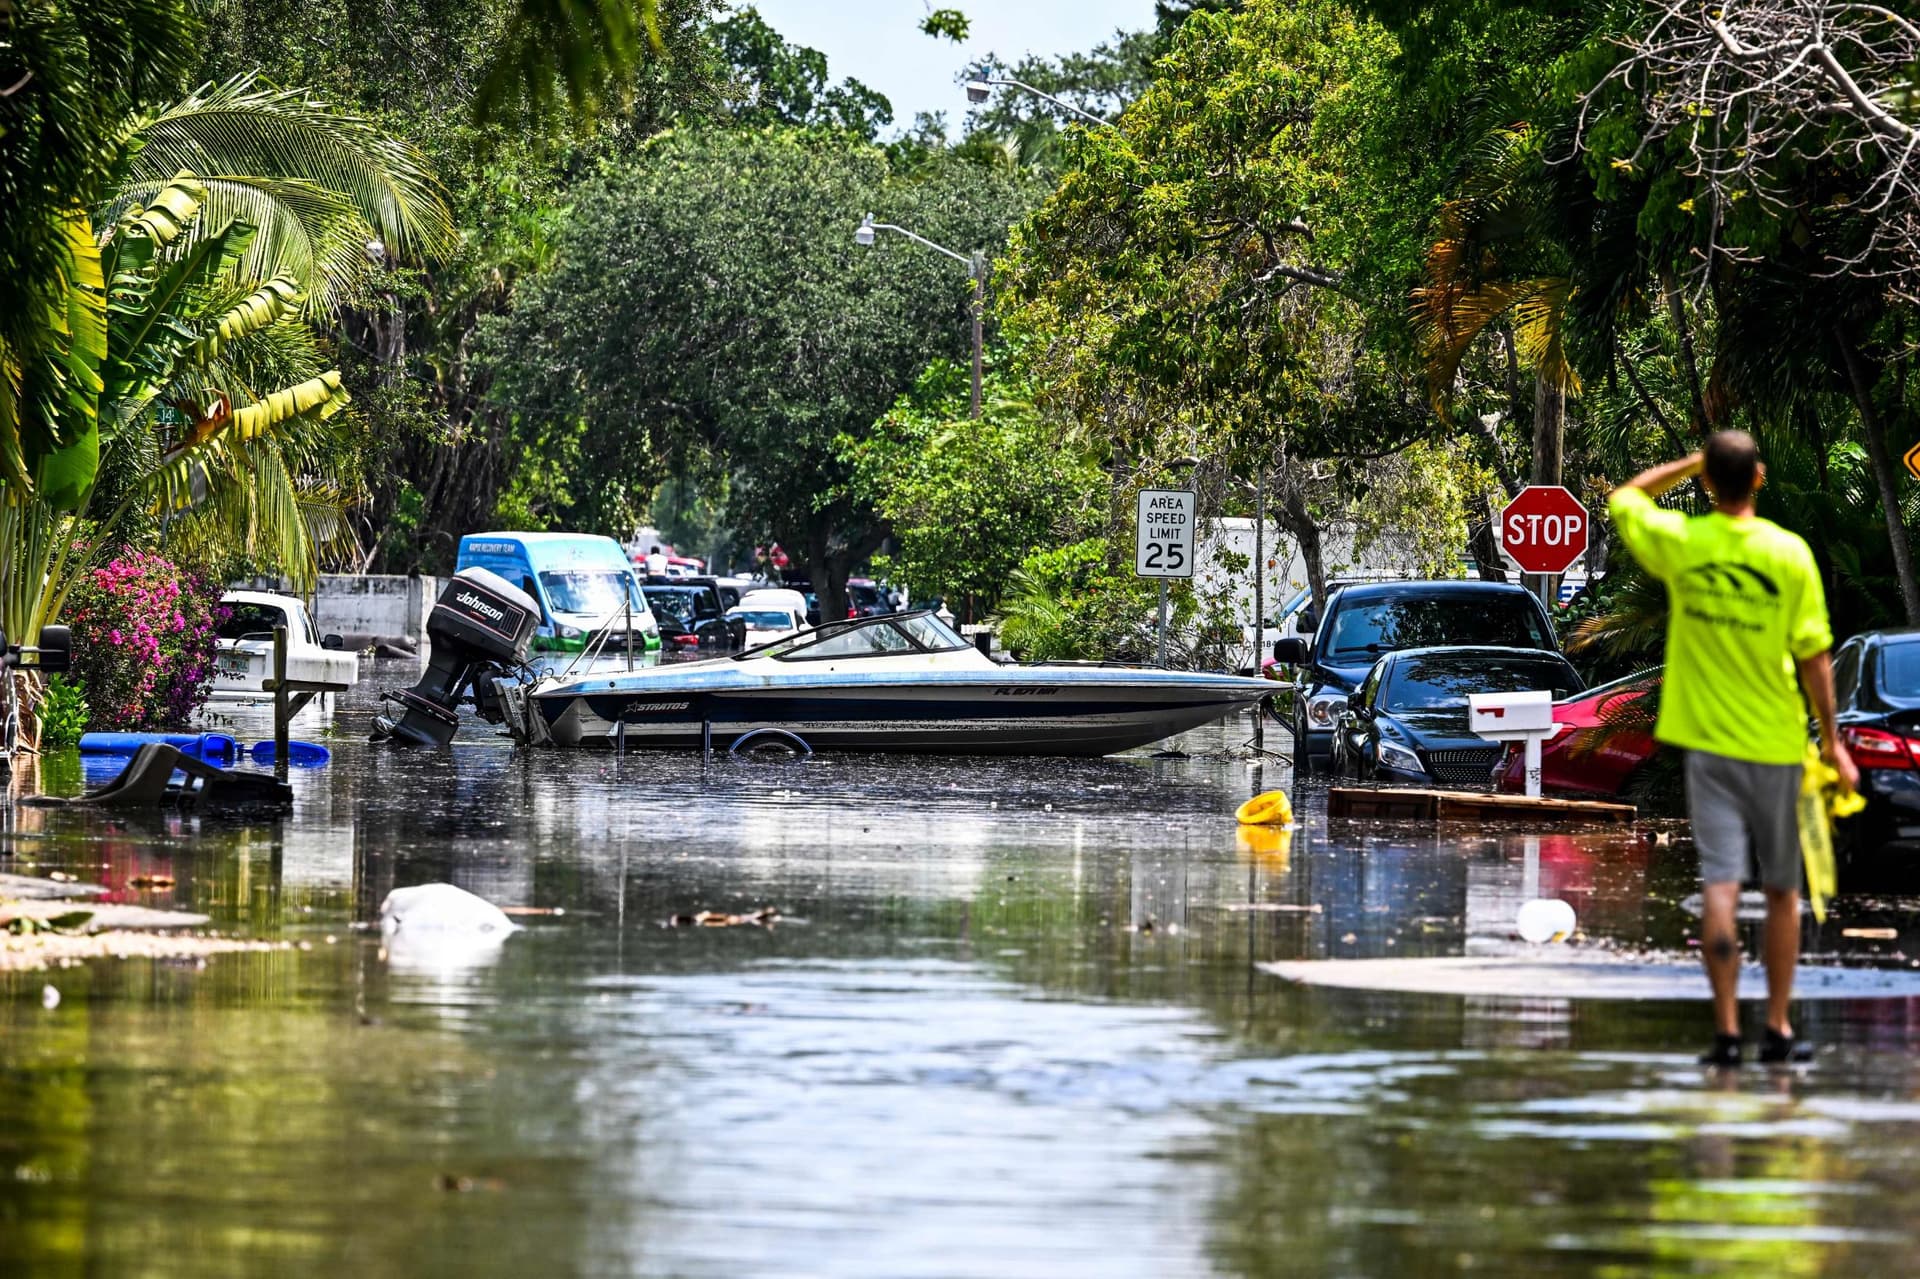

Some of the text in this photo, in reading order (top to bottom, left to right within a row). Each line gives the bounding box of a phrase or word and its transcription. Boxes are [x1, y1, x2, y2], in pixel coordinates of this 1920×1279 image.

[1149, 497, 1184, 510] AREA
[1146, 512, 1186, 525] SPEED
[1150, 527, 1182, 539] LIMIT
[1507, 514, 1582, 546] STOP
[481, 543, 503, 553] RECOVERY
[503, 544, 516, 553] TEAM
[1144, 542, 1185, 570] 25
[456, 591, 504, 621] Johnson
[637, 702, 690, 712] STRATOS
